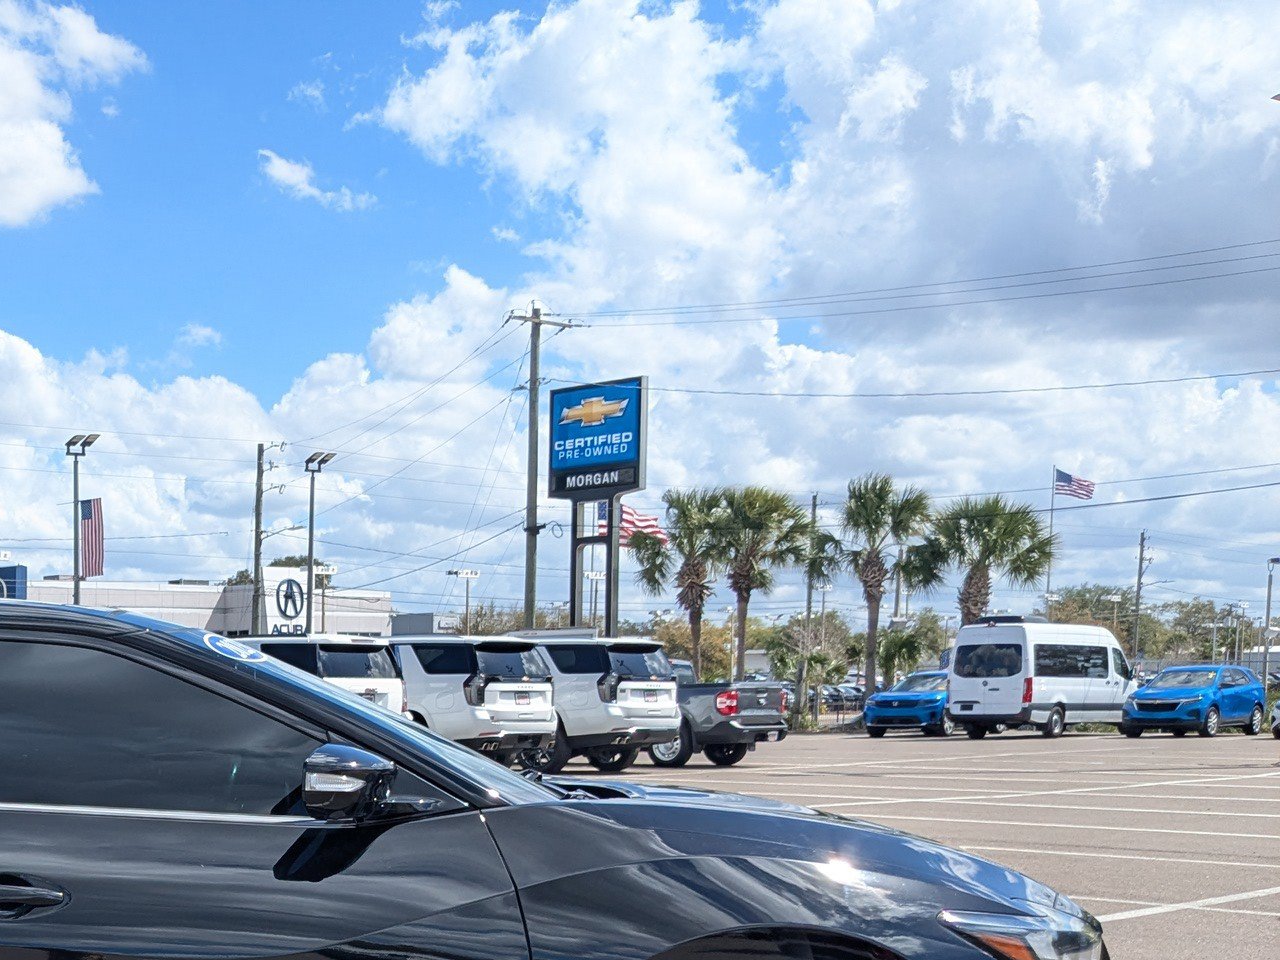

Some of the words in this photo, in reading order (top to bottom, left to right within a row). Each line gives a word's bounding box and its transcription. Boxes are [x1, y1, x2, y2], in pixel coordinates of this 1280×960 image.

[554, 432, 633, 451] CERTIFIED
[558, 443, 628, 460] PRE-OWNED
[566, 470, 619, 488] MORGAN
[271, 624, 308, 635] ACUR
